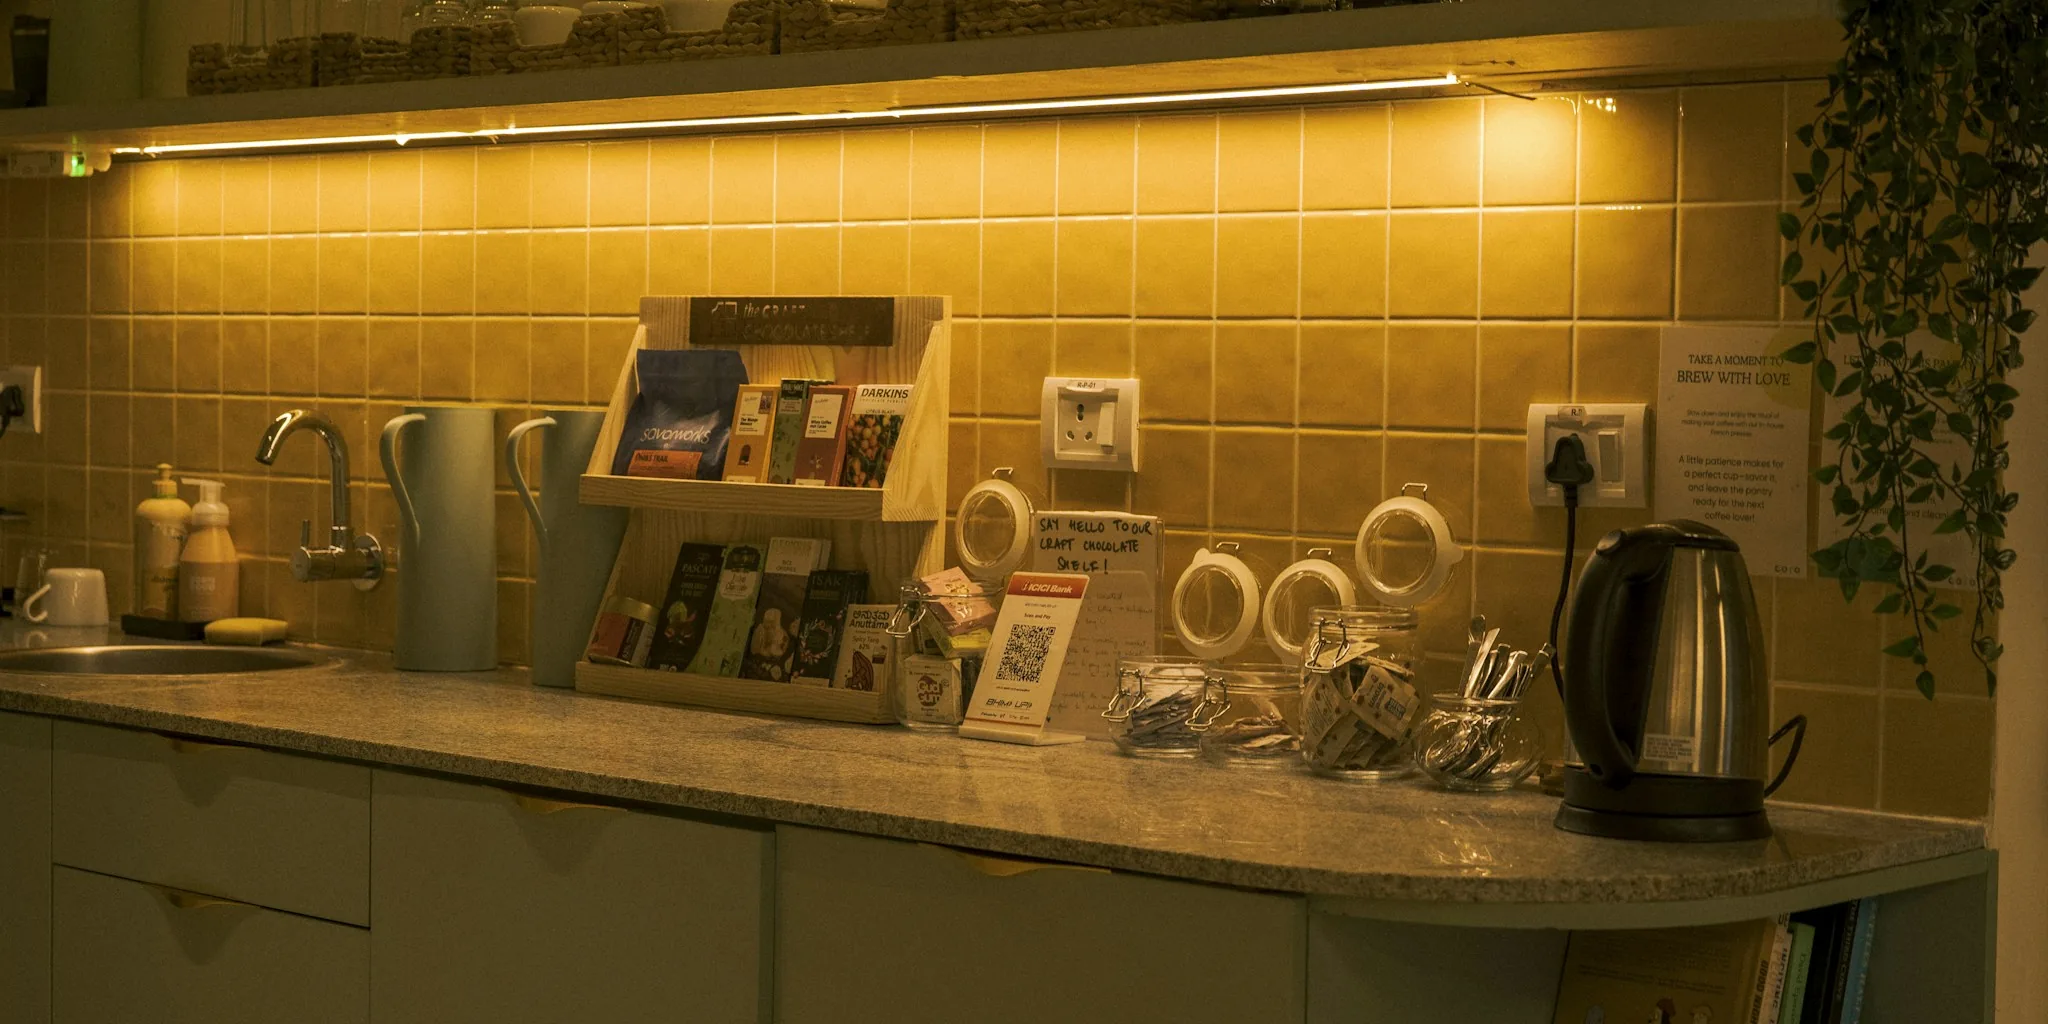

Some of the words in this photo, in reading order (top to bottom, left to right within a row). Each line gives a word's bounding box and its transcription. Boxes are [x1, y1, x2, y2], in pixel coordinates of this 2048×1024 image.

[743, 303, 760, 318] the
[762, 304, 806, 318] CRAFT
[1688, 354, 1713, 365] TAKE
[1715, 355, 1722, 365] A
[1724, 355, 1768, 366] MOMENT
[1770, 357, 1784, 368] TO
[1677, 370, 1714, 384] BREW
[1718, 371, 1752, 385] WITH
[1756, 372, 1791, 386] LOVE
[861, 388, 910, 399] DARKINS
[640, 426, 711, 444] savorworks
[1679, 455, 1685, 463] A
[1686, 454, 1703, 464] little
[1705, 456, 1741, 467] patience
[1743, 458, 1770, 467] makes
[1772, 459, 1785, 468] for
[1691, 469, 1721, 480] perfect
[1688, 483, 1704, 491] and
[1705, 484, 1728, 493] leave
[1730, 485, 1744, 494] the
[1745, 487, 1773, 497] pantry
[1692, 498, 1717, 508] ready
[1718, 498, 1730, 507] for
[1731, 499, 1745, 508] the
[1746, 501, 1765, 509] next
[1704, 511, 1731, 521] coffee
[1732, 512, 1755, 523] lover!
[1039, 518, 1059, 532] SAY
[1069, 519, 1105, 533] HELLO
[1113, 519, 1129, 532] TO
[1131, 521, 1153, 536] OUR
[1039, 537, 1075, 551] CRAFT
[1083, 539, 1139, 553] CHOCOLATE
[681, 563, 717, 574] PASCATI
[1028, 583, 1050, 593] ICICI
[1050, 584, 1073, 594] Bank
[849, 619, 889, 629] Anuttama
[986, 698, 1012, 707] BHIM
